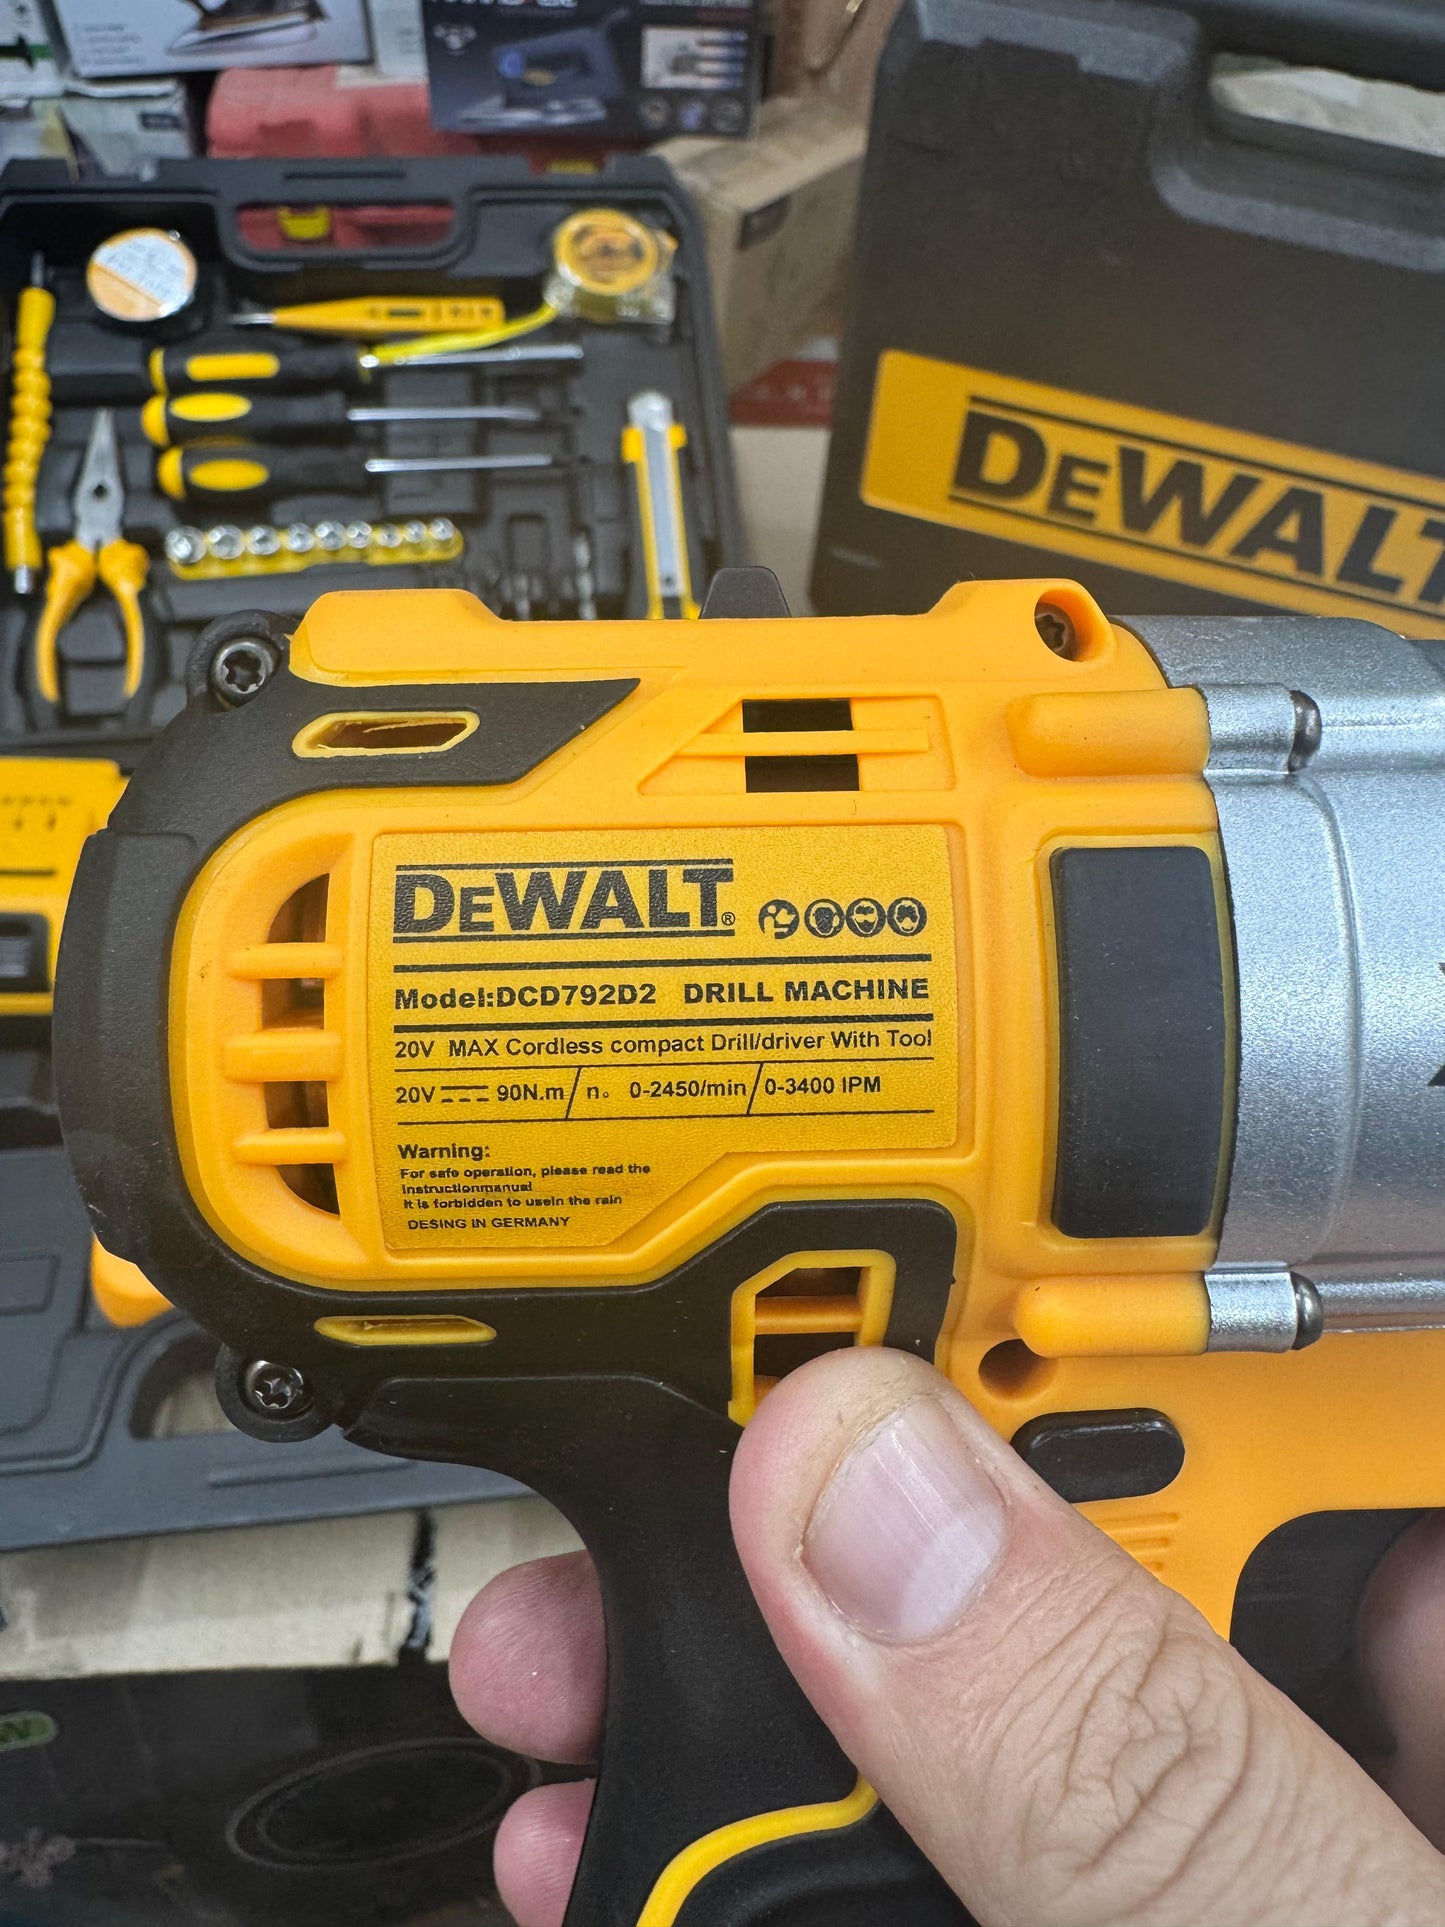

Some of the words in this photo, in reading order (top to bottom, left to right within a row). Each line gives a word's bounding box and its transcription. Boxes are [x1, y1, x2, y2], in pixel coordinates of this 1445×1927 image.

[395, 985, 656, 1009] Model:DCD792D2
[684, 982, 773, 1003] DRILL
[785, 977, 929, 1001] MACHINE
[395, 1040, 434, 1058] 20V
[448, 1038, 499, 1057] MAX
[505, 1036, 603, 1056] Cordless
[611, 1034, 705, 1057] compact
[711, 1031, 825, 1052] Drill/driver
[831, 1030, 880, 1048] With
[886, 1028, 932, 1047] Tool
[395, 1087, 436, 1104] 20V
[497, 1084, 565, 1102] 90N.m
[629, 1079, 747, 1098] 0-2450/min
[764, 1077, 835, 1096] 0-3400
[841, 1075, 881, 1094] IPM
[397, 1143, 490, 1161] Warning:
[400, 1168, 426, 1180] For
[429, 1167, 459, 1179] safe
[541, 1165, 588, 1179] please
[592, 1163, 624, 1176] read
[627, 1162, 651, 1175] the
[432, 1196, 504, 1210] forbidden
[506, 1197, 522, 1208] to
[568, 1195, 592, 1207] the
[594, 1194, 623, 1206] rain
[408, 1218, 468, 1231] DESING
[471, 1218, 488, 1230] IN
[490, 1216, 571, 1229] GERMANY
